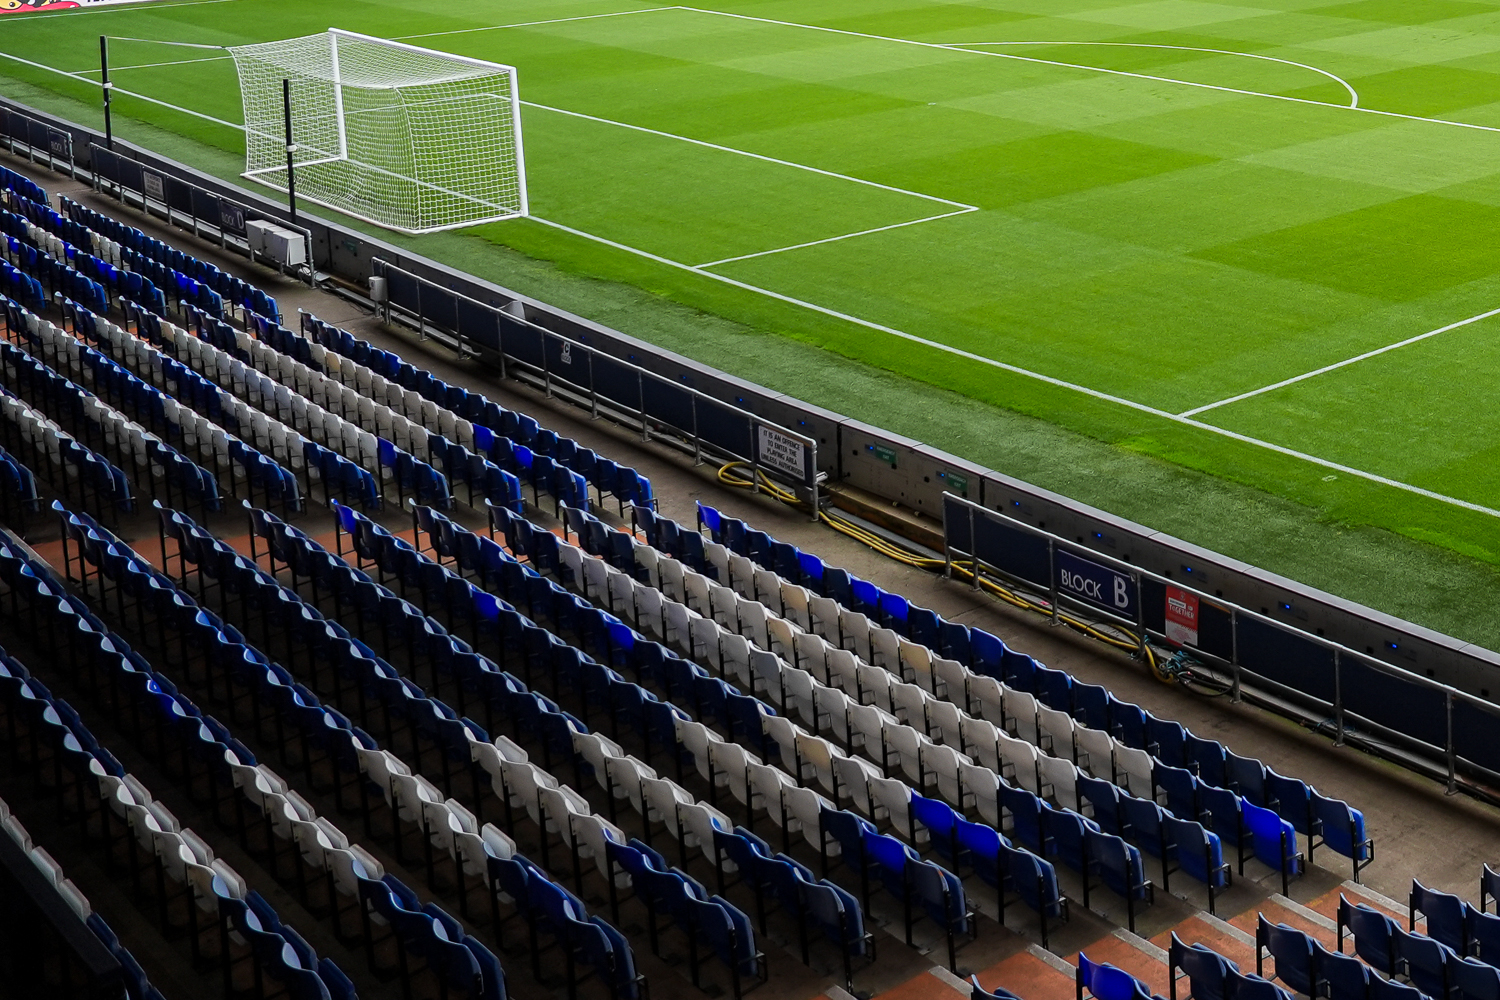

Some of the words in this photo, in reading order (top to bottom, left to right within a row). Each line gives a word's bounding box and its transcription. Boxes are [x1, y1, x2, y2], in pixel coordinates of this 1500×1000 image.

[222, 212, 235, 226] BLOCK
[237, 211, 244, 229] D
[774, 433, 781, 441] AN
[782, 435, 800, 450] OFFENCE
[774, 442, 788, 452] ENTER
[789, 447, 797, 458] THE
[761, 453, 777, 465] UNLESS
[778, 460, 804, 477] AUTHORISED
[766, 447, 784, 460] PLAYING
[786, 455, 797, 466] AREA
[1061, 568, 1102, 600] BLOCK
[1114, 575, 1129, 608] B
[1169, 604, 1194, 619] TOGETHER
